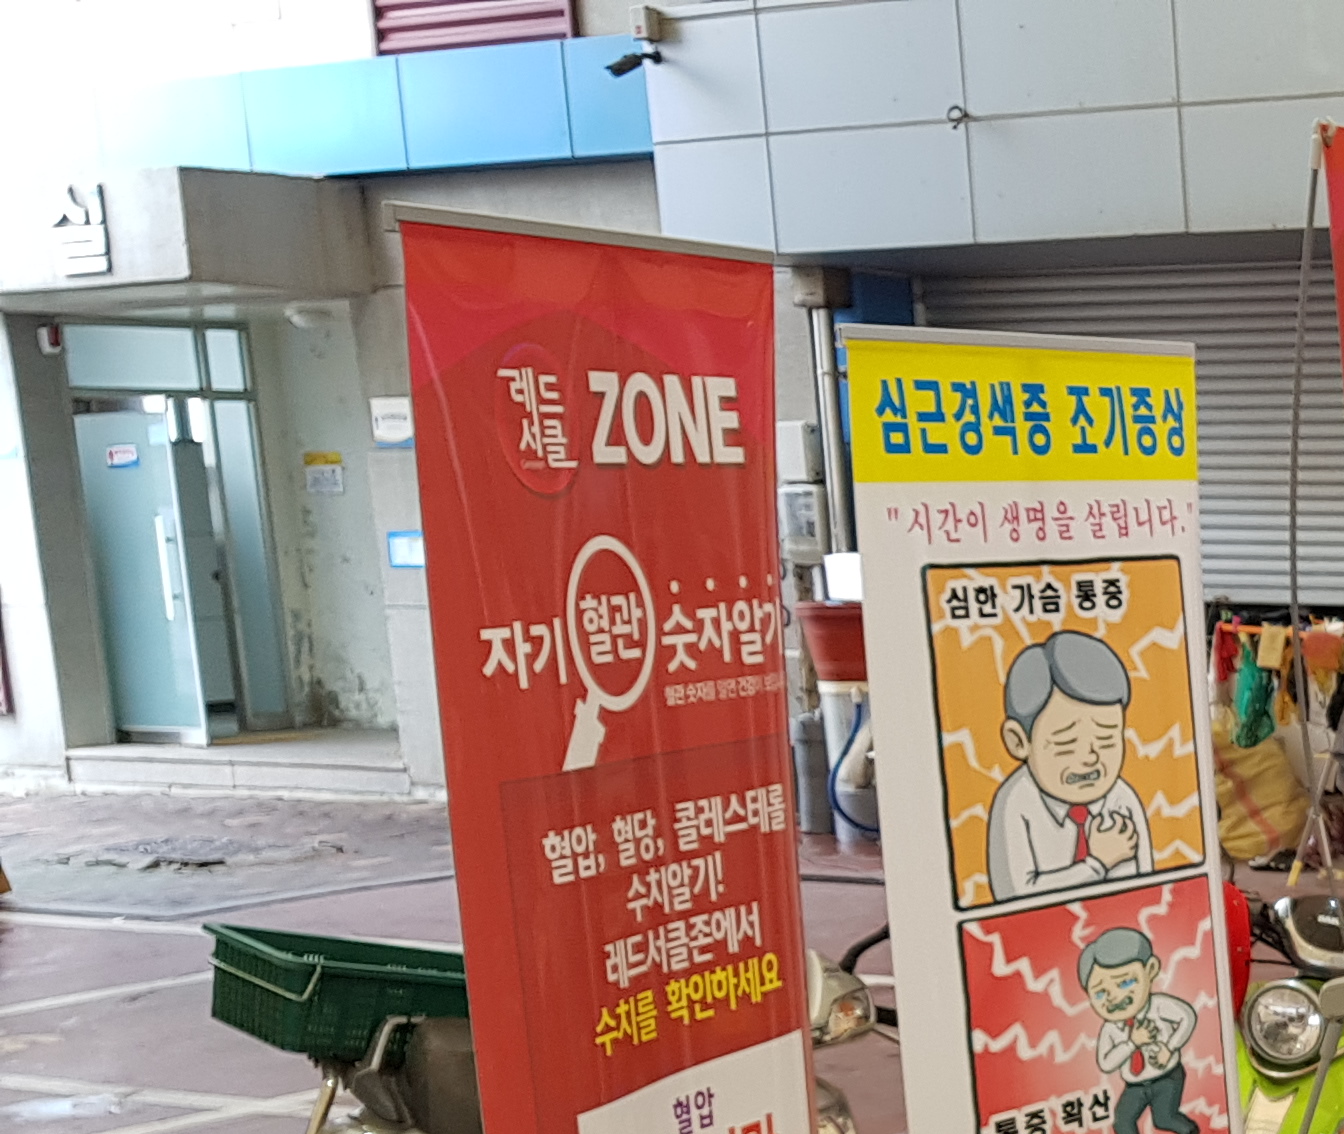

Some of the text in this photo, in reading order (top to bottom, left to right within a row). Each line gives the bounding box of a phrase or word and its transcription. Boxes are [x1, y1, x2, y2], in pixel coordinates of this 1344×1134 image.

[496, 366, 747, 467] 레드 ZONE
[874, 376, 1186, 457] 심근경색증 조기증상
[999, 500, 1075, 544] 생명을
[578, 592, 645, 666] 혈관
[945, 578, 1124, 620] 심한 가슴 통증
[542, 783, 787, 886] 혈압, 혈당, 콜레스테롤
[625, 850, 725, 924] 수치알기!
[603, 901, 763, 990] 레드서클존에서
[593, 951, 783, 1057] 수치를 확인하세요
[1061, 1089, 1112, 1130] 확산
